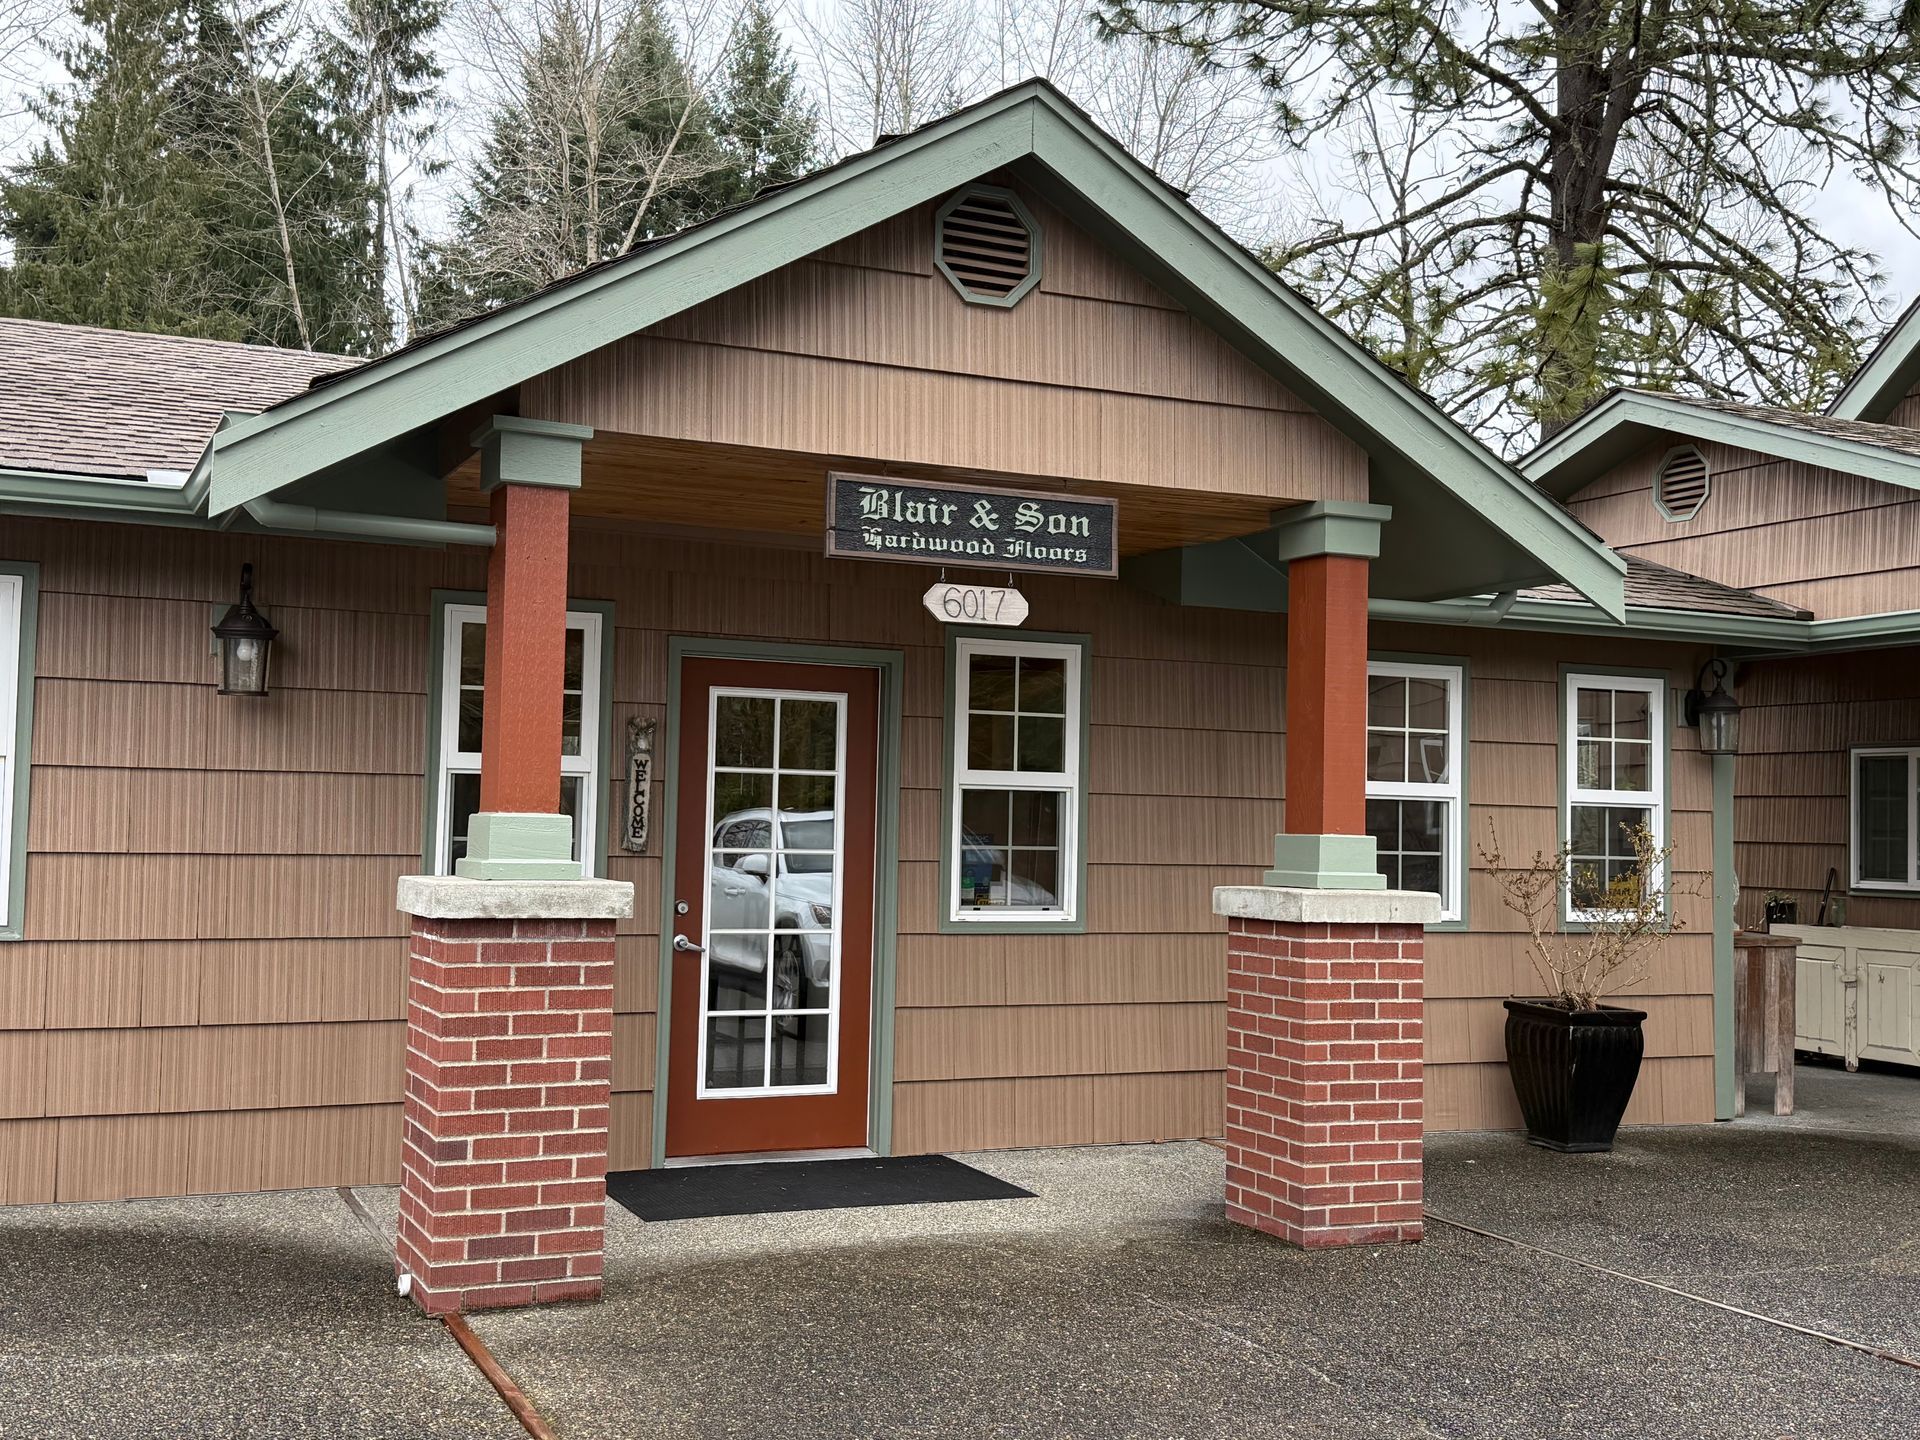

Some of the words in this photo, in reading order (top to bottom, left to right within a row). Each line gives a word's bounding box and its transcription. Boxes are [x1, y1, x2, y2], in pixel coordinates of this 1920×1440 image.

[858, 486, 959, 526] Blair
[969, 499, 999, 531] &
[1014, 502, 1090, 538] Son
[861, 525, 995, 556] Hardwood
[1002, 537, 1088, 562] Floors
[943, 586, 1006, 621] 6017
[631, 759, 649, 839] WELCOME
